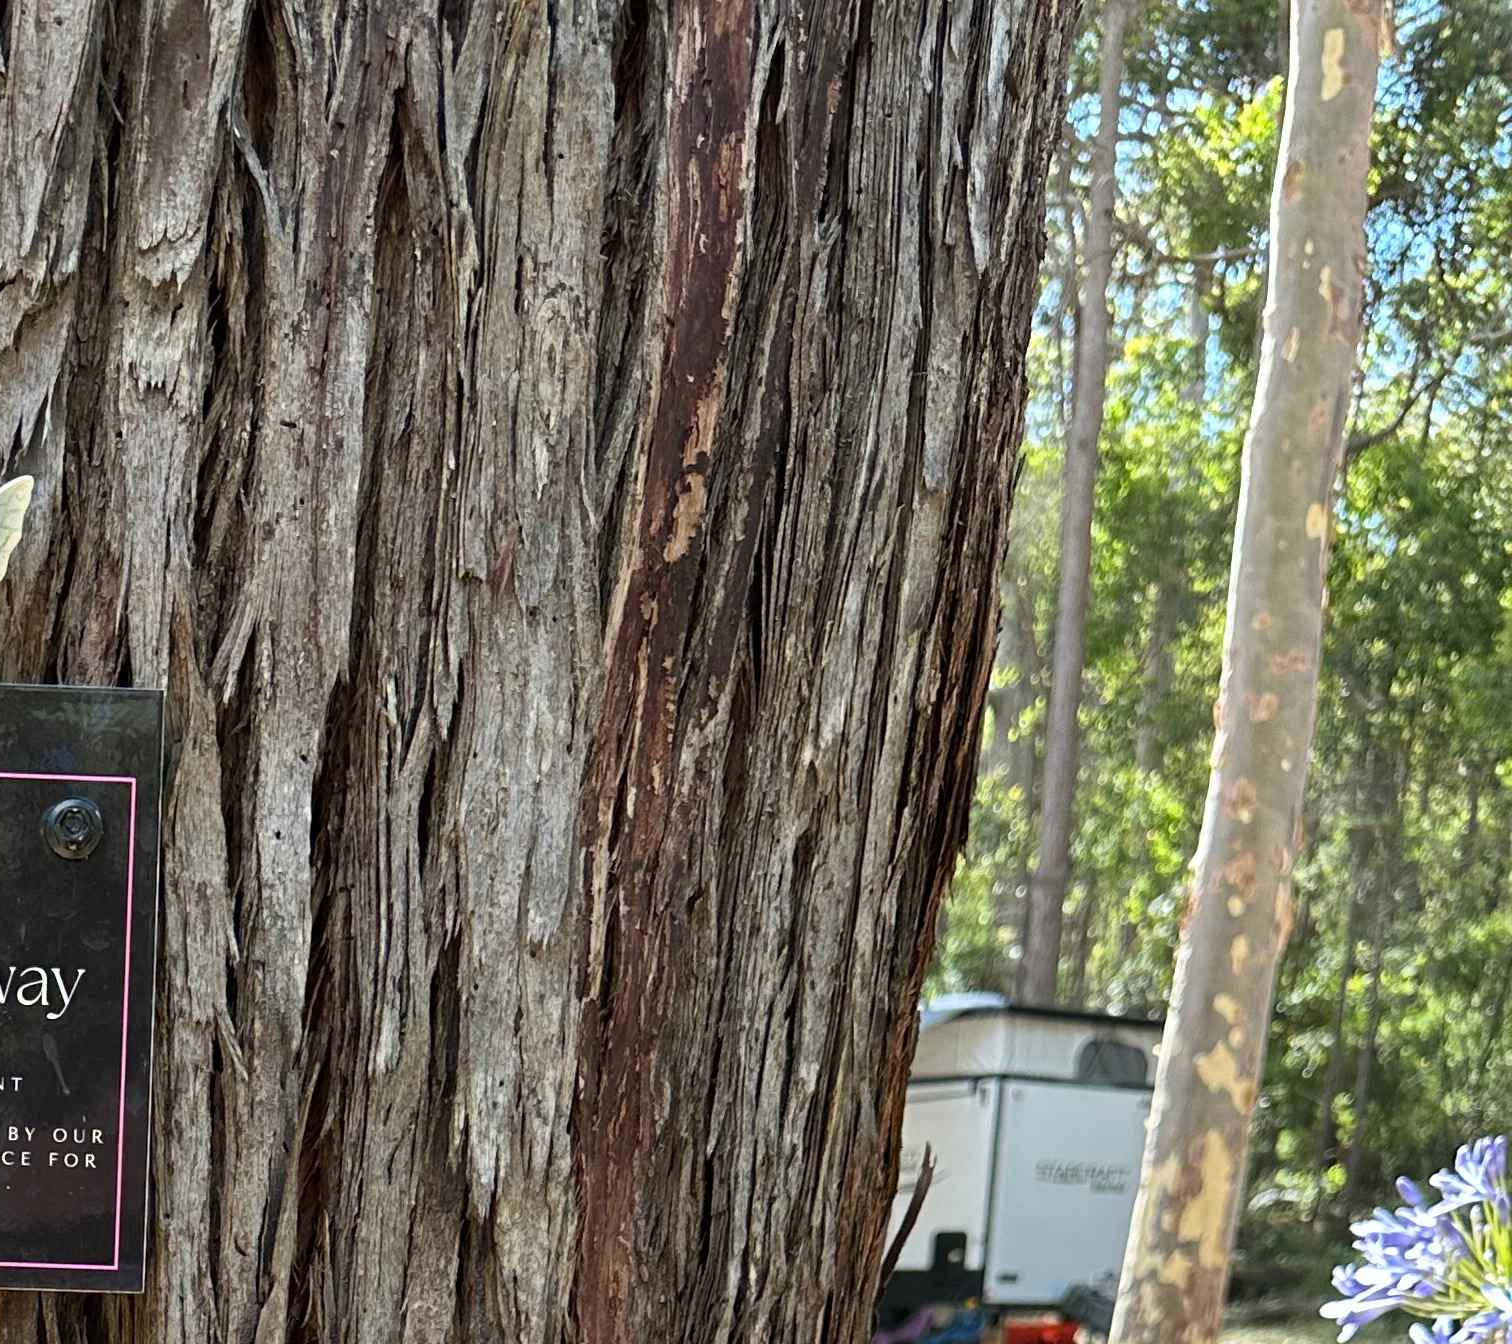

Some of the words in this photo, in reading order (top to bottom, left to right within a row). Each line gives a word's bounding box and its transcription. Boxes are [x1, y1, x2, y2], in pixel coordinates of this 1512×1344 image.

[8, 1127, 37, 1142] BY
[52, 1127, 104, 1145] OUR
[49, 1152, 98, 1169] FOR
